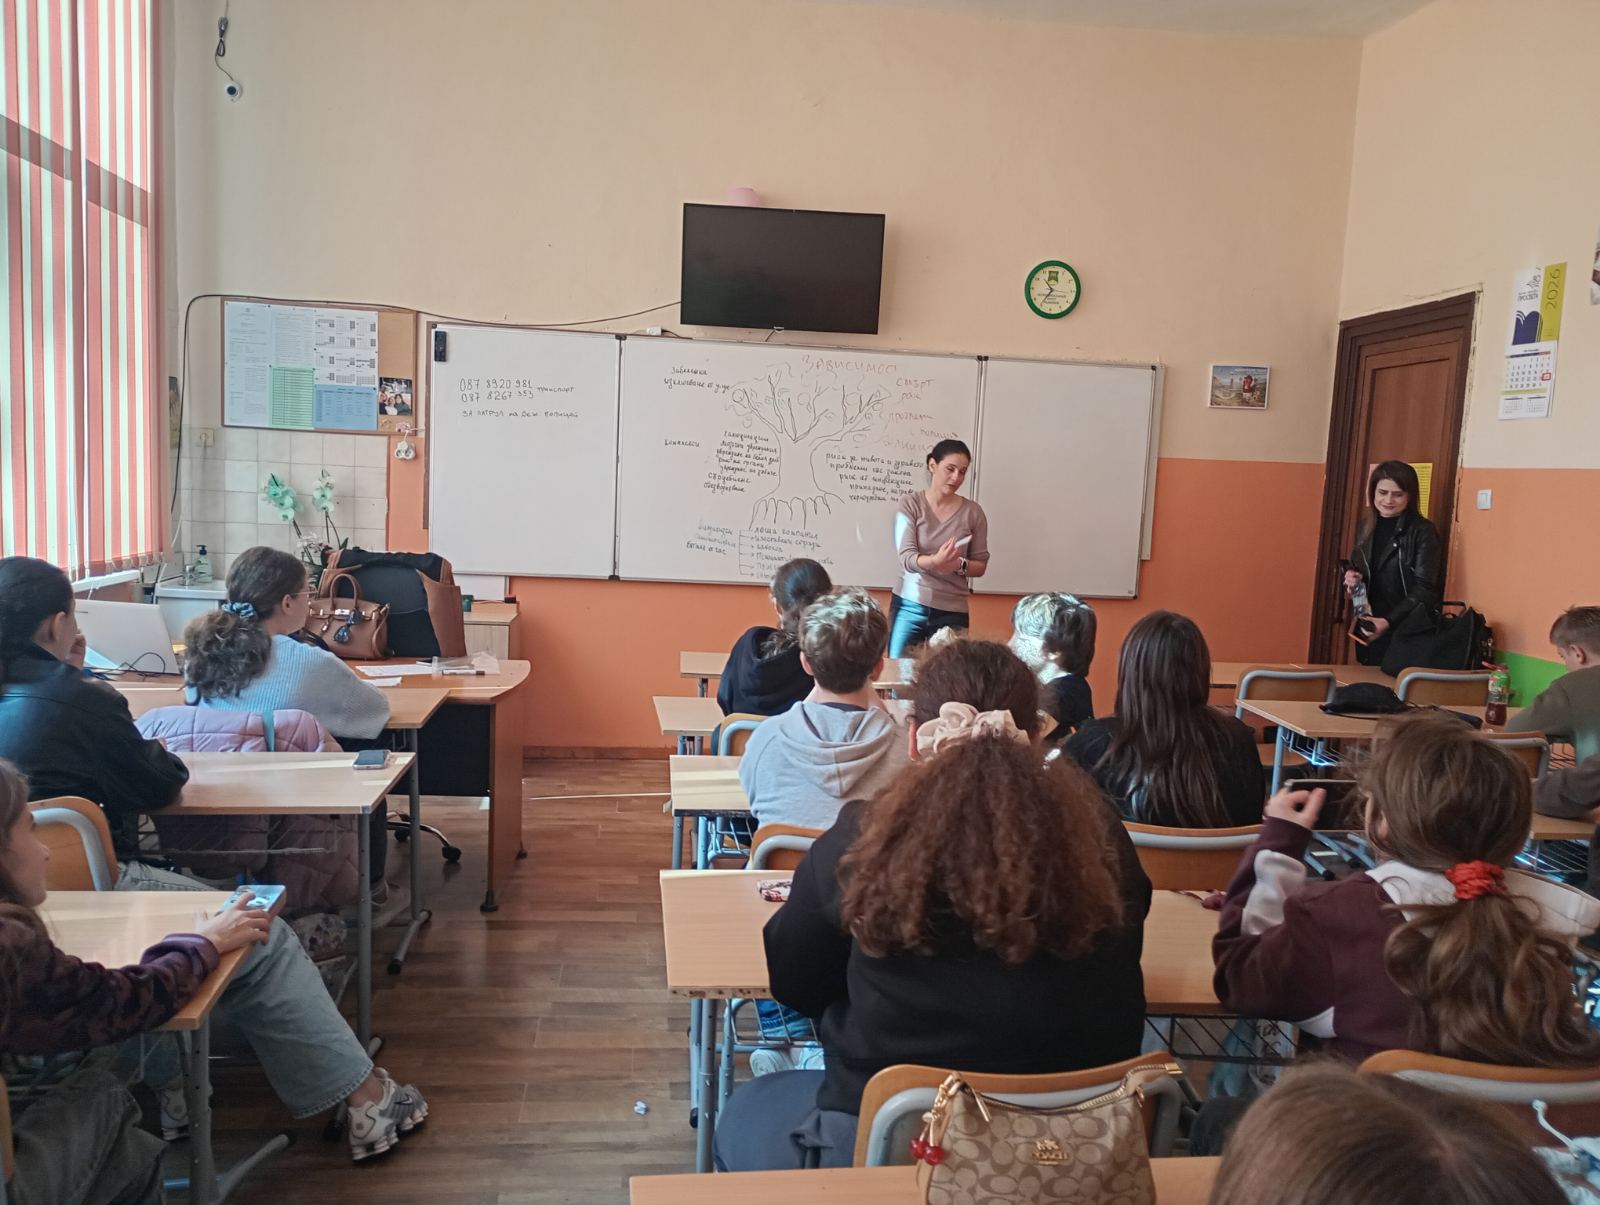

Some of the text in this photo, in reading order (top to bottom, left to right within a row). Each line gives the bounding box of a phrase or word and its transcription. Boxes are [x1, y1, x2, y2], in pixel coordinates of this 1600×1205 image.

[1545, 268, 1561, 310] 2026
[459, 378, 481, 392] 087
[486, 379, 512, 389] 8920
[461, 391, 481, 403] 087
